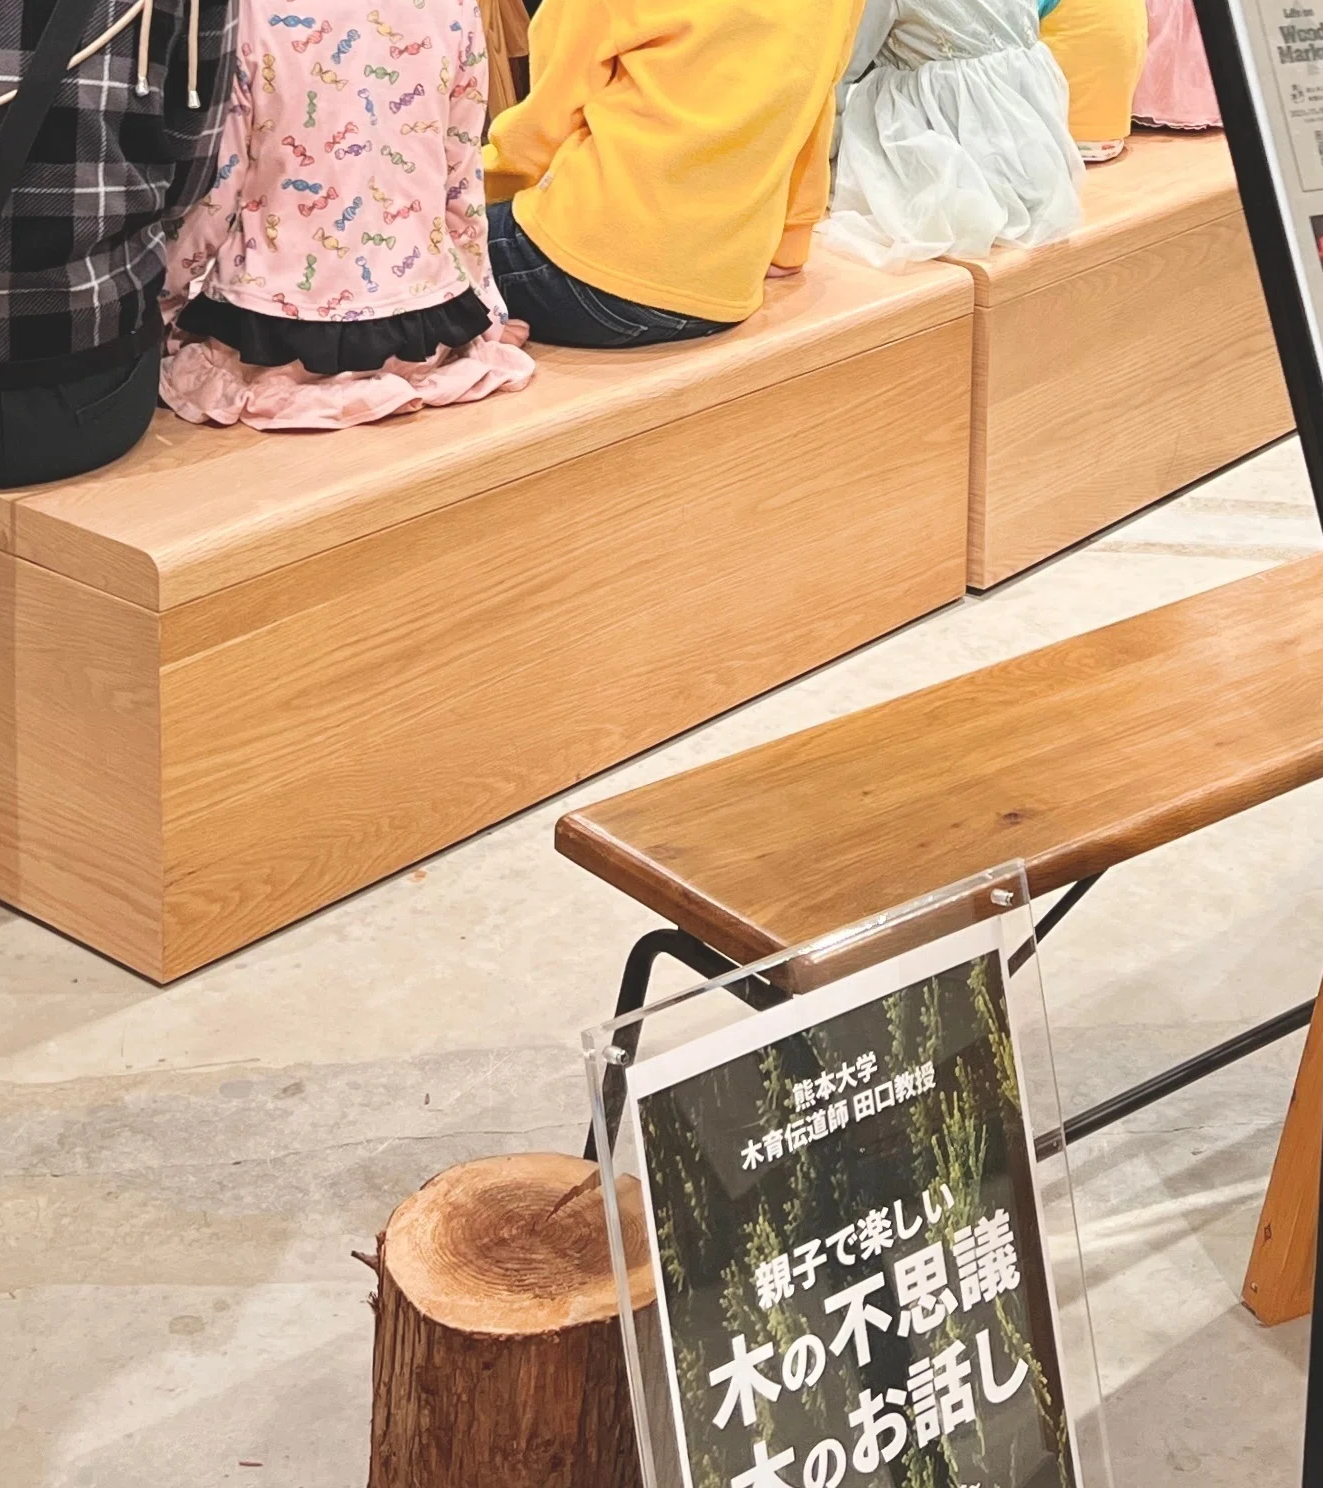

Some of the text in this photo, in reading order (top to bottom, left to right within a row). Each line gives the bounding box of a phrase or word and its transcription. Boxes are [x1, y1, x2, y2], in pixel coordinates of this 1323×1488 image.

[741, 1060, 937, 1172] 木育伝道師 田口教授
[792, 1051, 877, 1113] 熊本大学
[754, 1182, 955, 1311] 親子で楽しい
[709, 1208, 1021, 1430] 木の不思議
